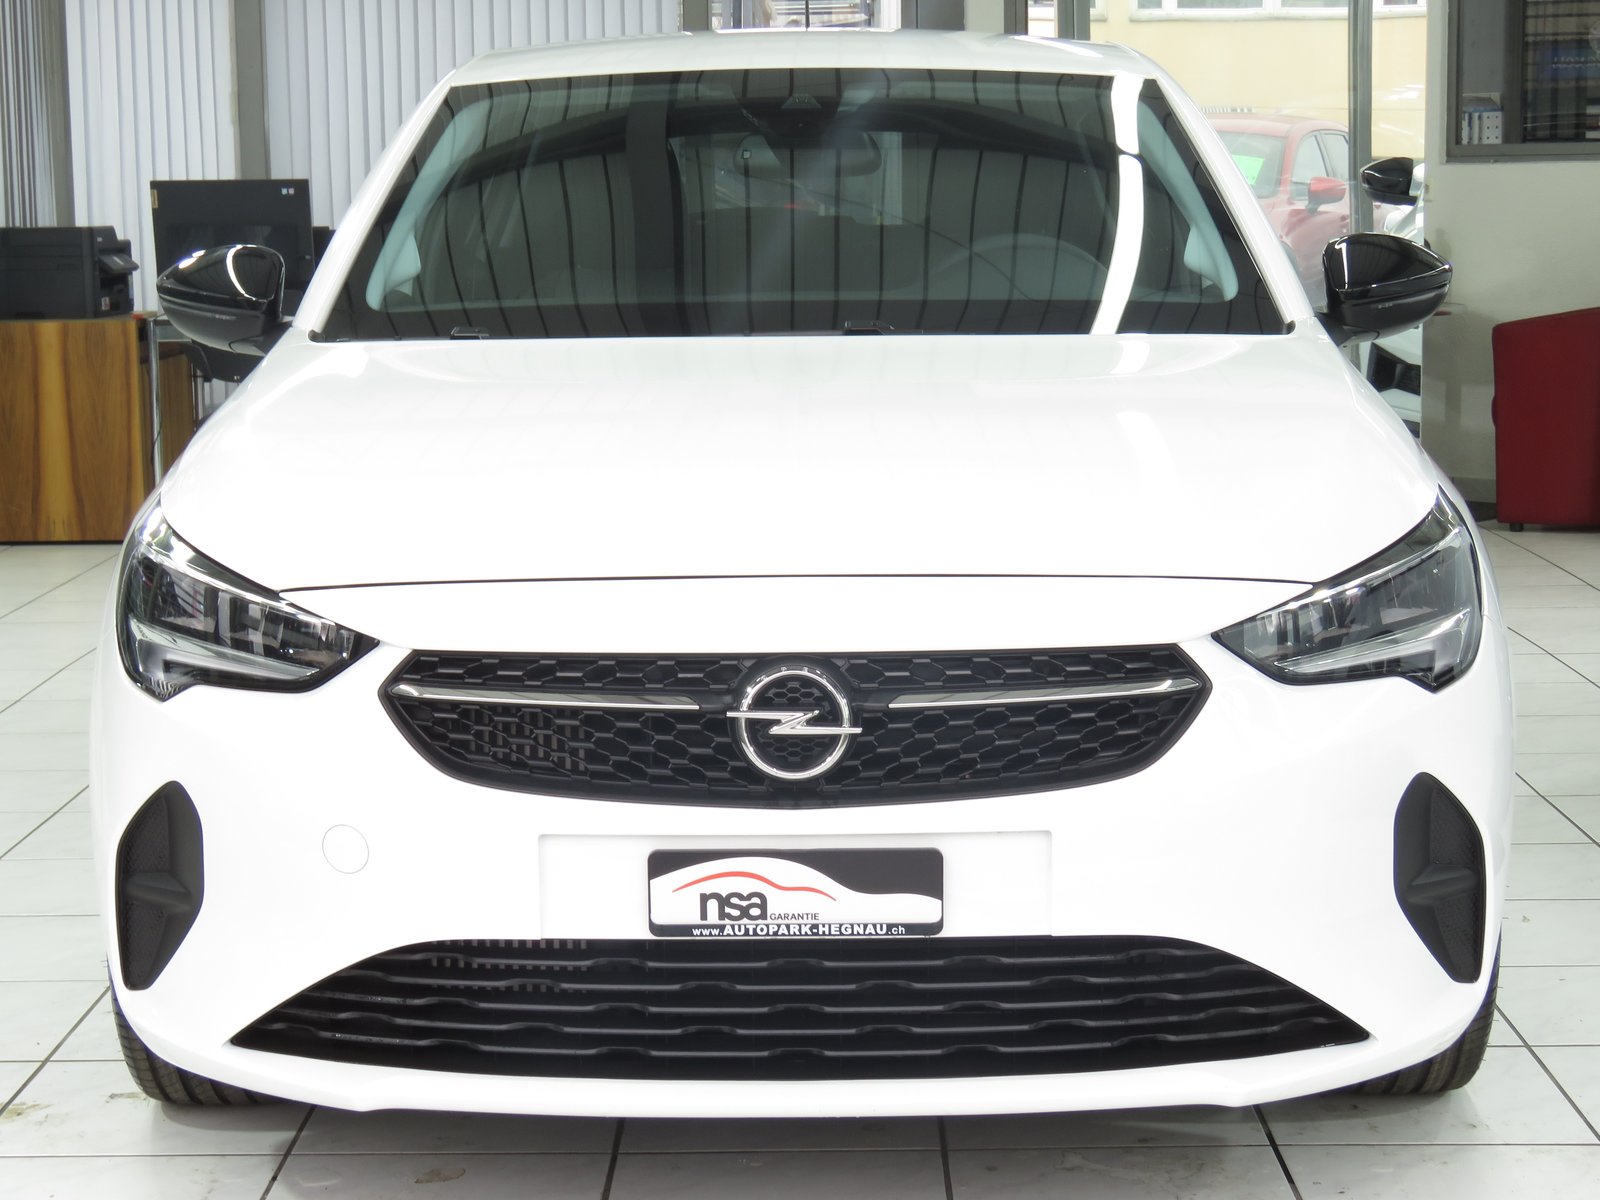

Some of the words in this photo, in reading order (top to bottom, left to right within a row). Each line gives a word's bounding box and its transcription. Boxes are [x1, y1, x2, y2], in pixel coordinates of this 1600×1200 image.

[700, 892, 767, 921] nsa
[770, 913, 819, 921] GARANTIE
[692, 924, 905, 936] www.AUTOPARK-HEGNAU.ch
